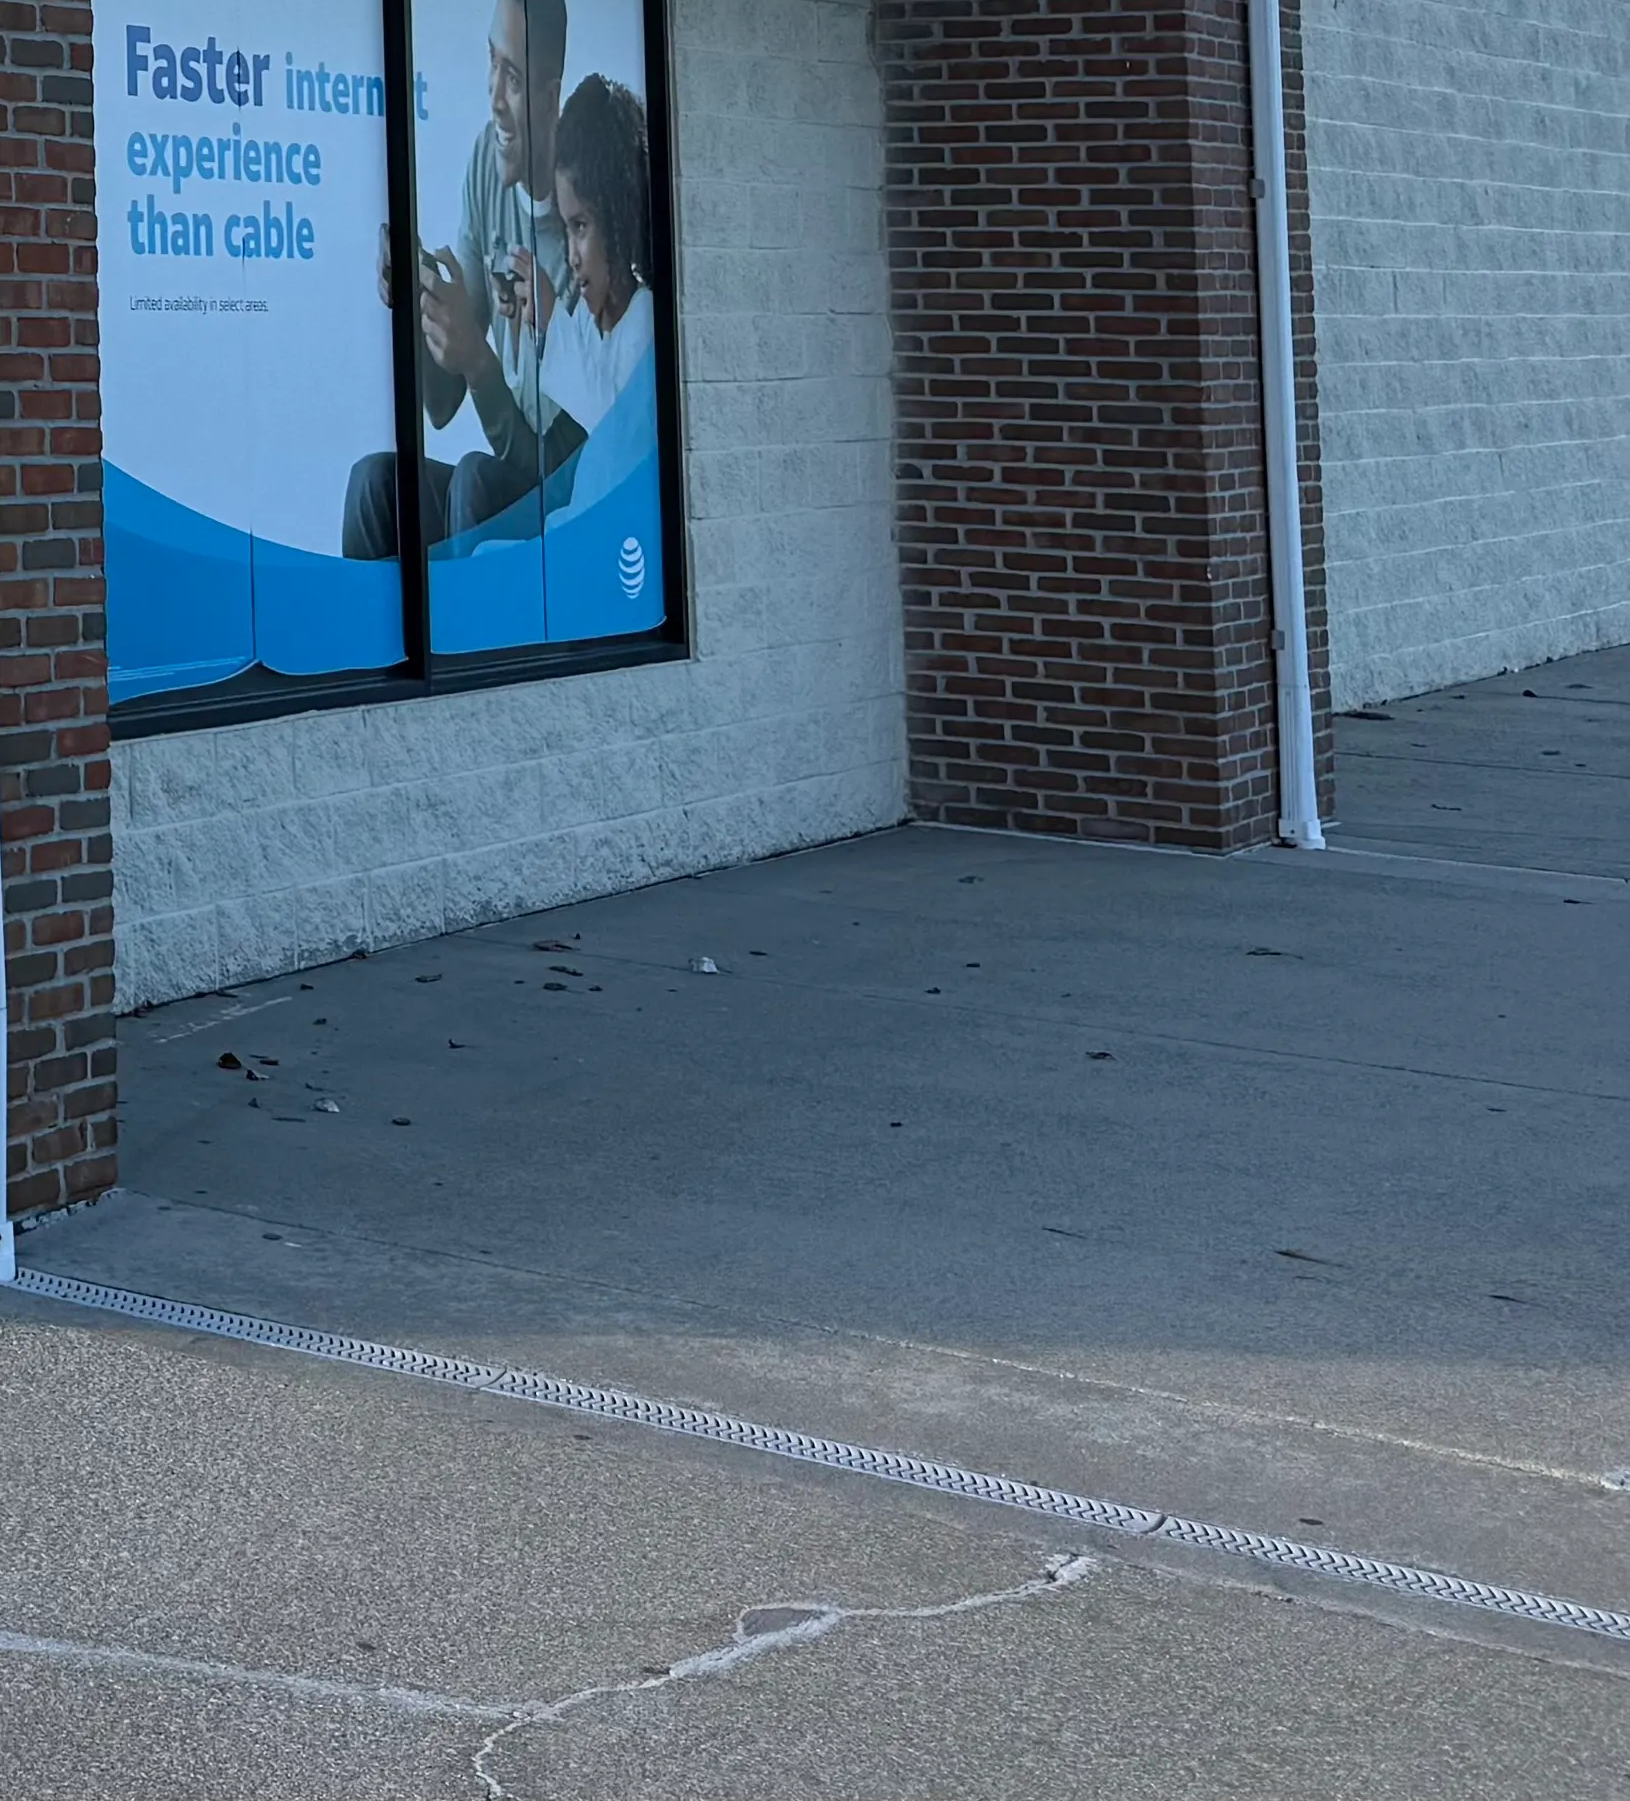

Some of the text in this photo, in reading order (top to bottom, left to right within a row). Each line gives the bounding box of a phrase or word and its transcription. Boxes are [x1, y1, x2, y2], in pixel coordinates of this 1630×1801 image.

[125, 24, 429, 120] Faster internt
[126, 121, 322, 195] experience
[126, 193, 315, 260] than cable
[129, 296, 163, 312] Limited
[163, 296, 208, 315] availability
[209, 298, 218, 311] in
[218, 297, 244, 313] select
